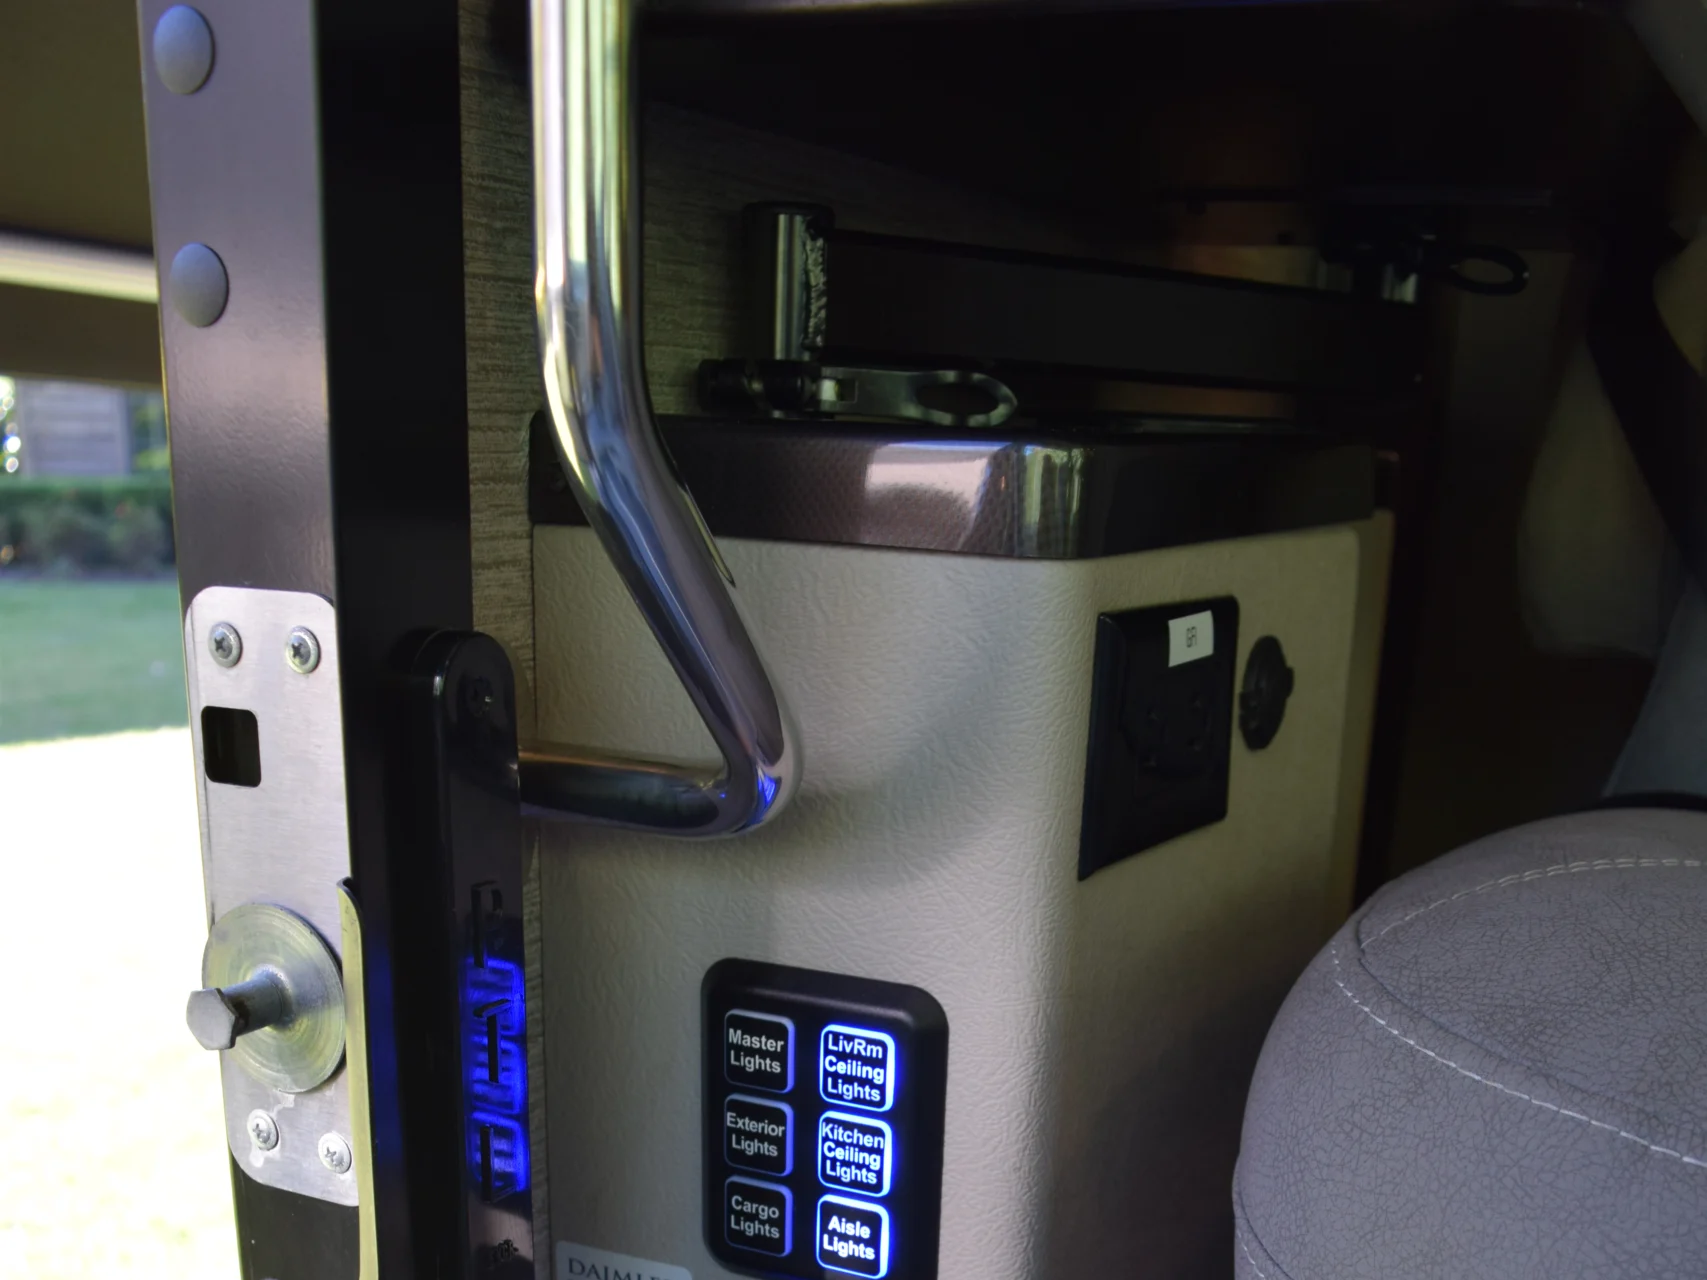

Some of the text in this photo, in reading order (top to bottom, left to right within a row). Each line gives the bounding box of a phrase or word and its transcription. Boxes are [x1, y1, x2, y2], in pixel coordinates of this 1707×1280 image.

[728, 1028, 784, 1052] Master
[828, 1034, 882, 1059] LivRm
[730, 1050, 781, 1074] Lights
[825, 1055, 885, 1083] Ceiling
[827, 1077, 881, 1101] Lights
[726, 1112, 785, 1137] Exterior
[822, 1123, 885, 1150] Kitchen
[732, 1134, 778, 1157] Lights
[823, 1143, 881, 1170] Ceiling
[826, 1163, 877, 1185] Lights
[731, 1195, 779, 1219] Cargo
[730, 1215, 779, 1239] Lights
[828, 1216, 871, 1239] Aisle
[823, 1235, 875, 1260] Lights
